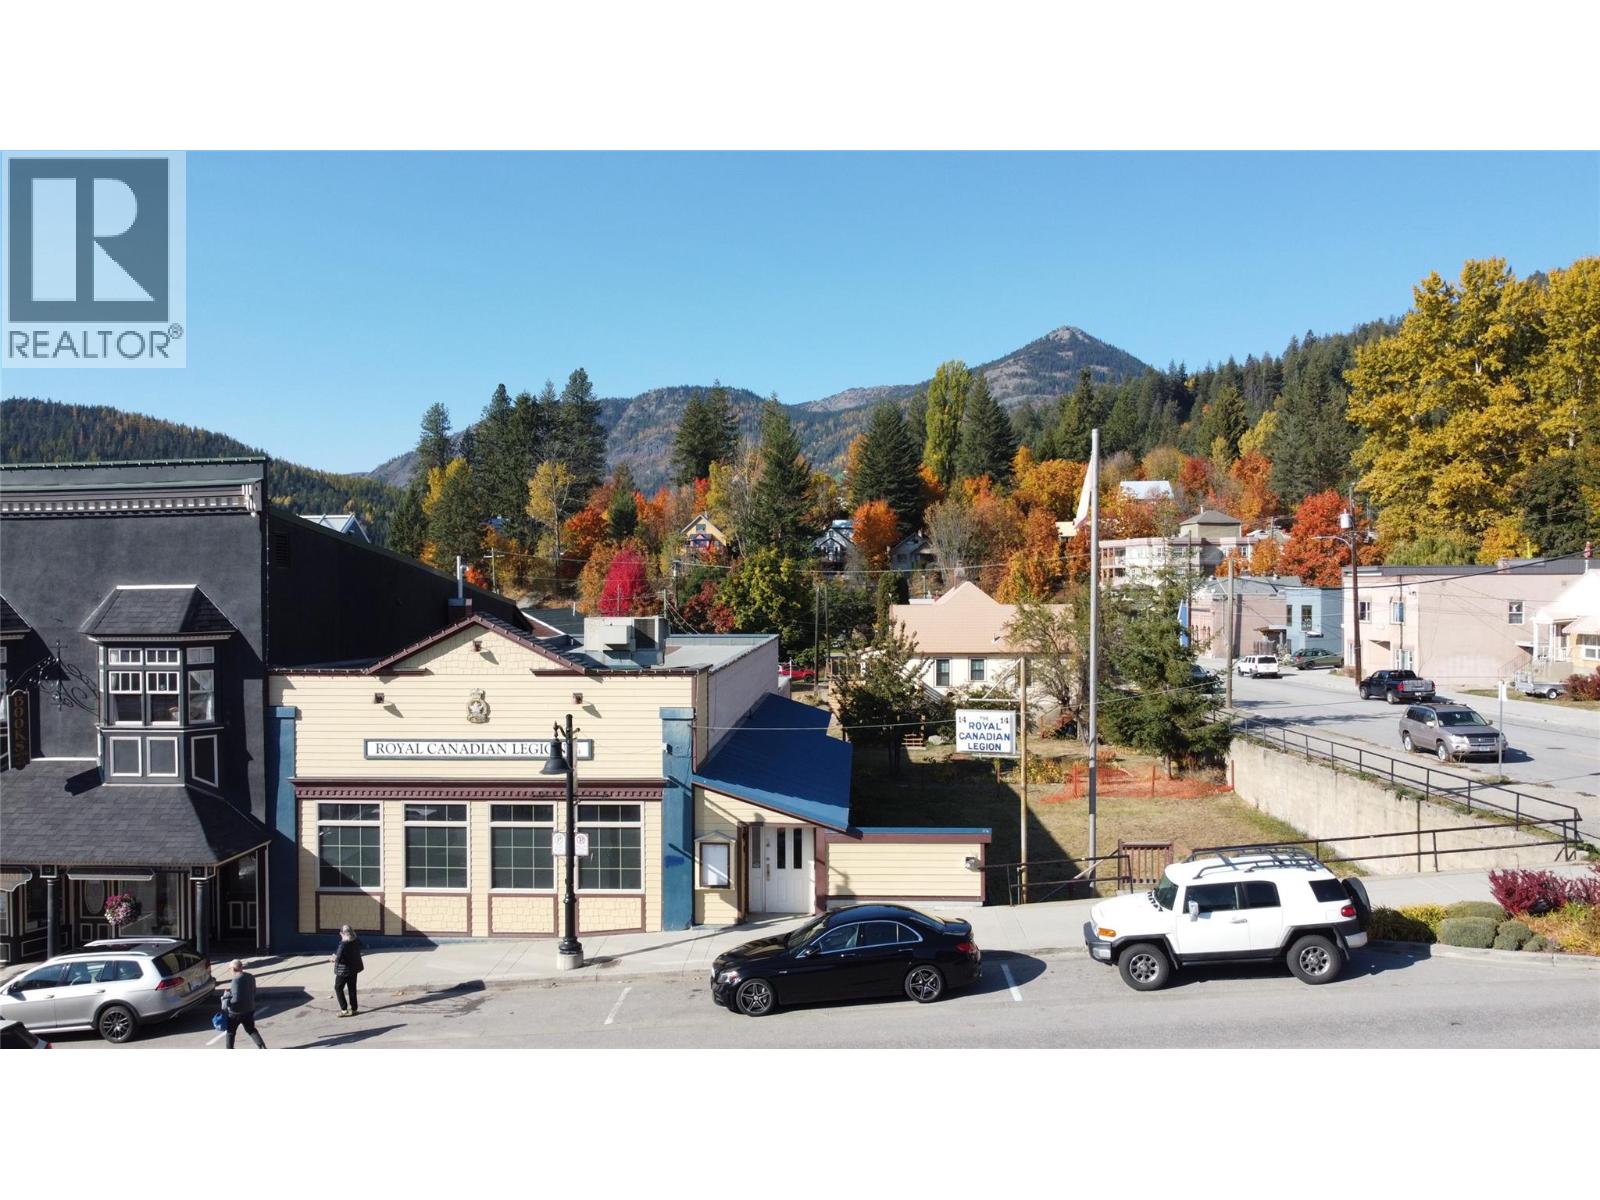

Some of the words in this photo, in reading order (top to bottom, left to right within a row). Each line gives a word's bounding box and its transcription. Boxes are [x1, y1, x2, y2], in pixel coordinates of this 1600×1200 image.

[968, 722, 1002, 731] ROYAL
[958, 732, 1010, 741] CANADIAN
[375, 742, 424, 755] ROYAL
[426, 742, 508, 755] CANADIAN
[967, 742, 1002, 751] LEGION
